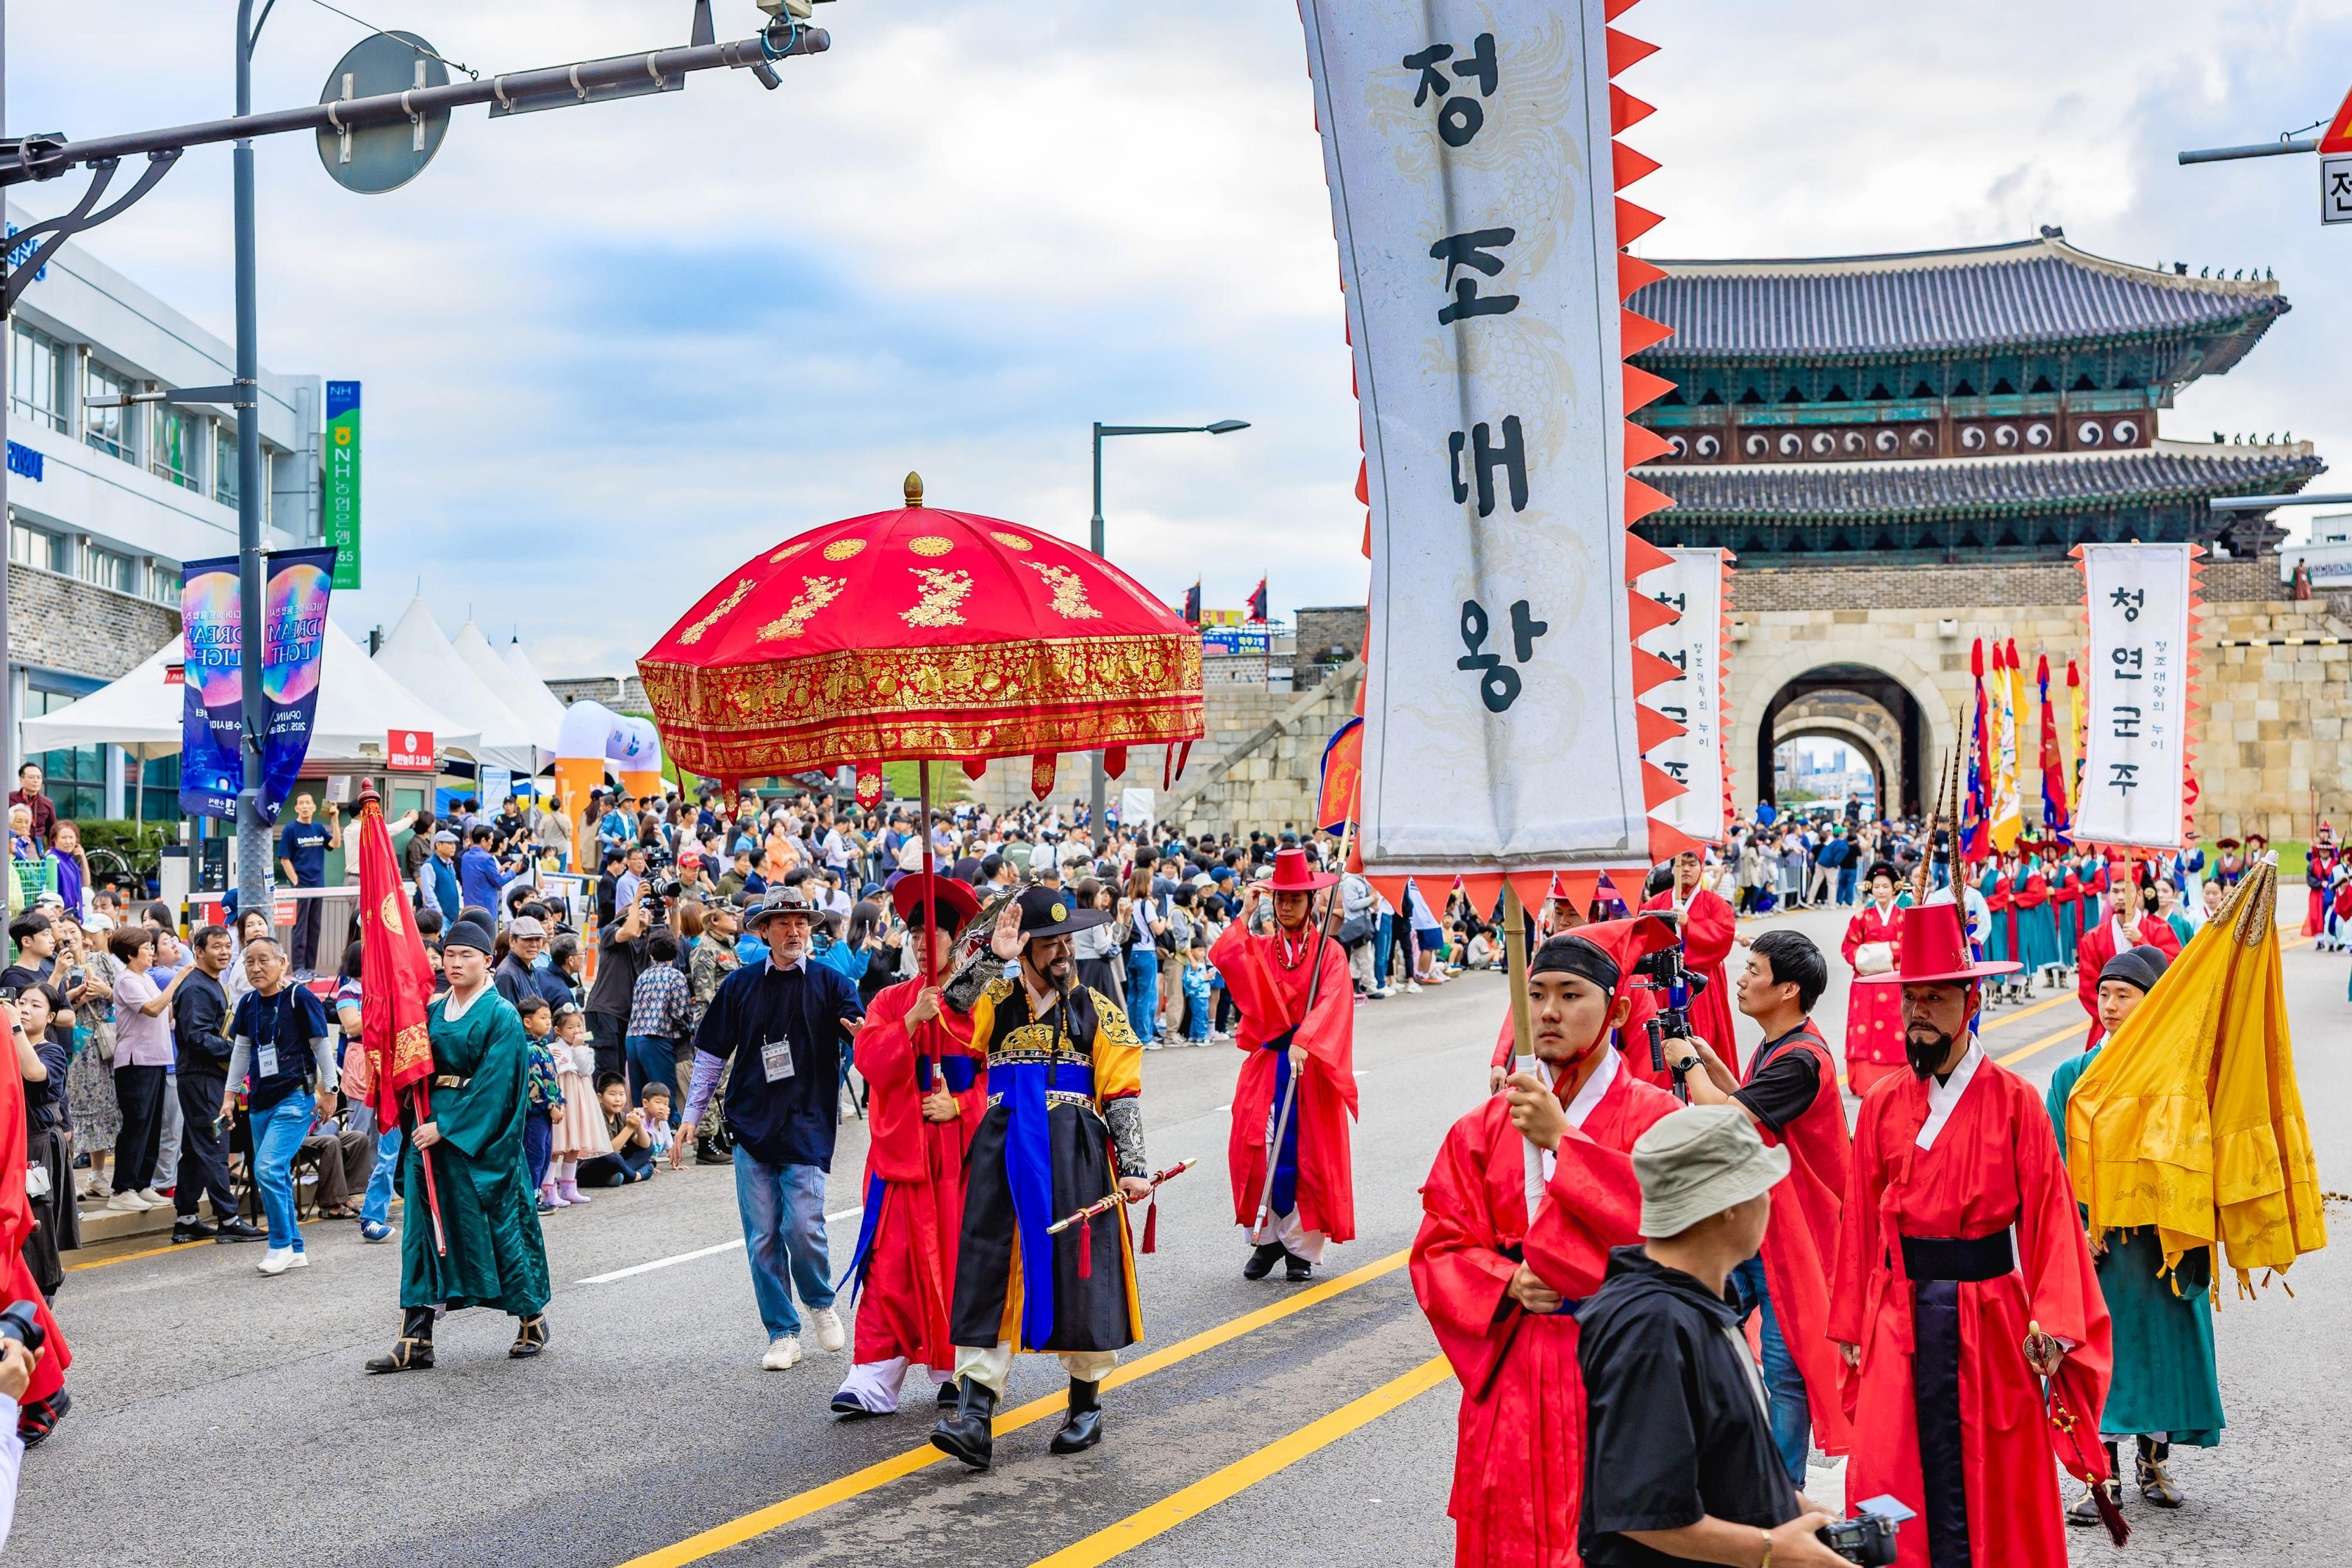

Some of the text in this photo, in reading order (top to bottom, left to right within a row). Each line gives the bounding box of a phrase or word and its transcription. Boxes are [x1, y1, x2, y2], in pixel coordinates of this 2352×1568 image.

[330, 386, 351, 395] NH
[1402, 32, 1548, 713] 정조대왕
[335, 551, 354, 562] 65
[1693, 643, 1709, 747] 정조대왕의 누이
[2108, 586, 2144, 797] 청연군주
[2151, 641, 2167, 749] 정조대왕의 누이
[415, 755, 431, 766] 2.5M
[765, 1048, 787, 1056] STAFF
